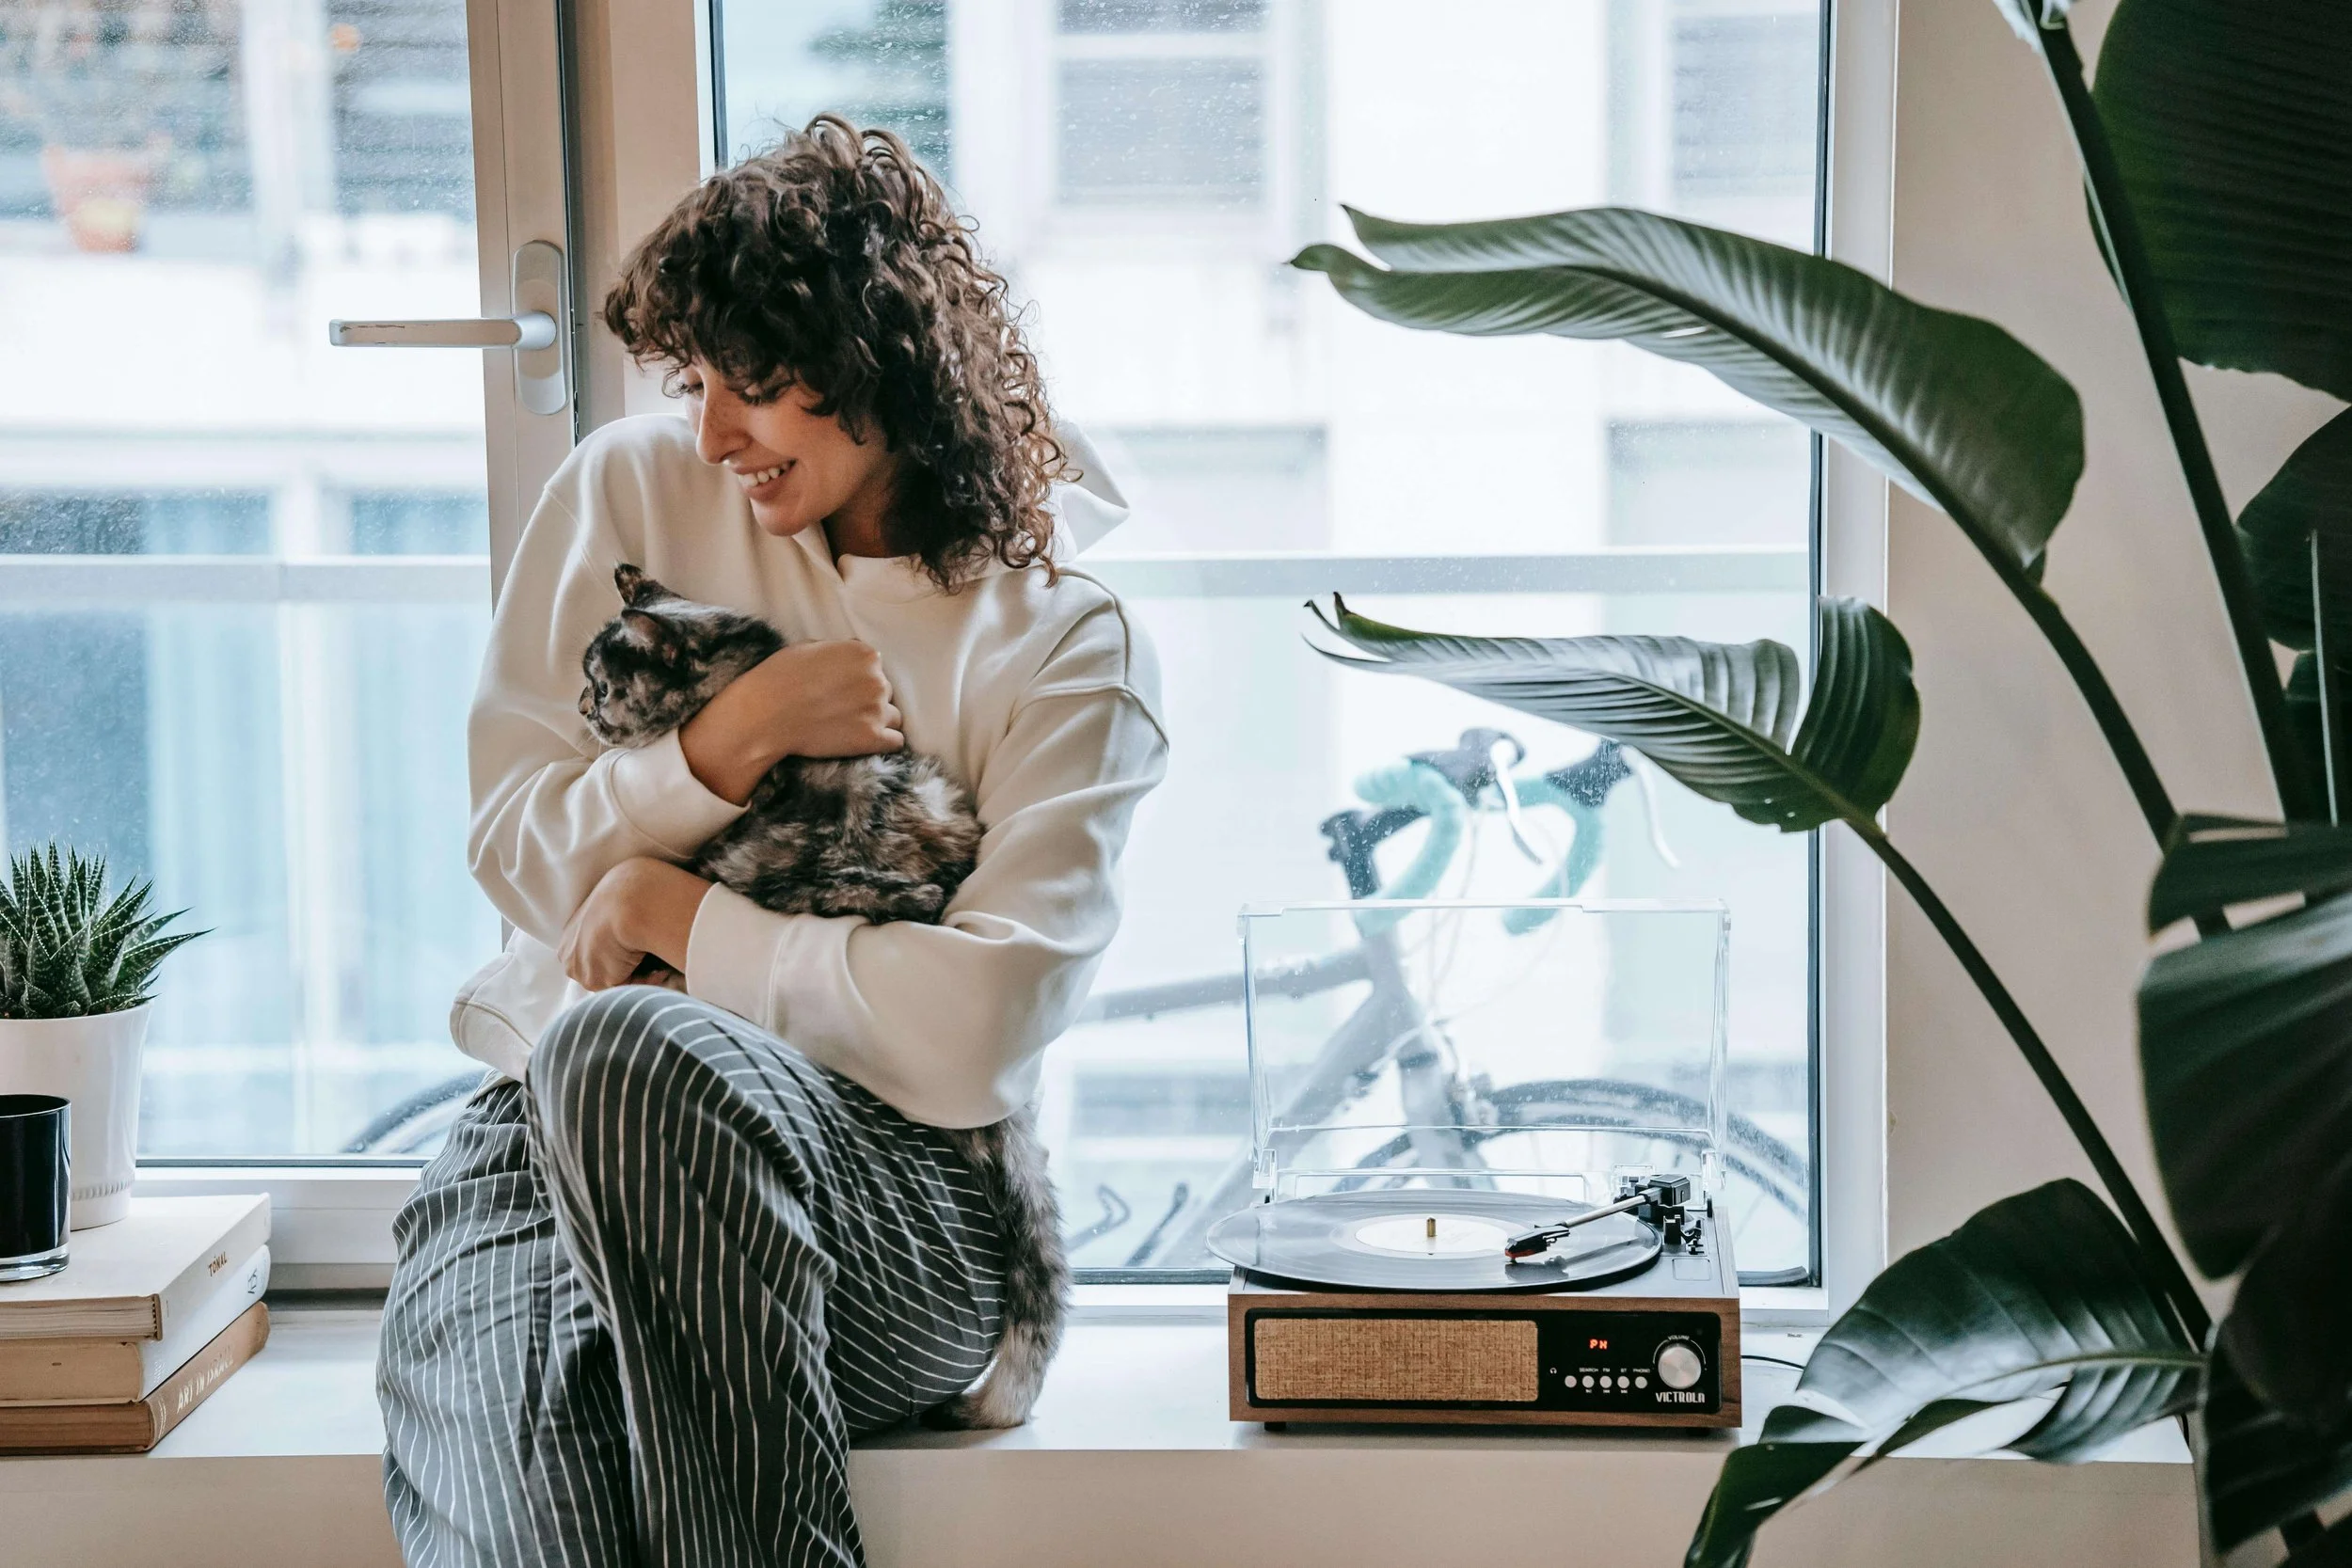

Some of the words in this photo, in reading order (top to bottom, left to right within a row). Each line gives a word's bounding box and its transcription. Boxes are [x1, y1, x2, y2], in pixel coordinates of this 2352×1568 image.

[177, 1383, 193, 1414] ART
[196, 1372, 205, 1396] IN
[1655, 1391, 1706, 1403] VICTROLA
